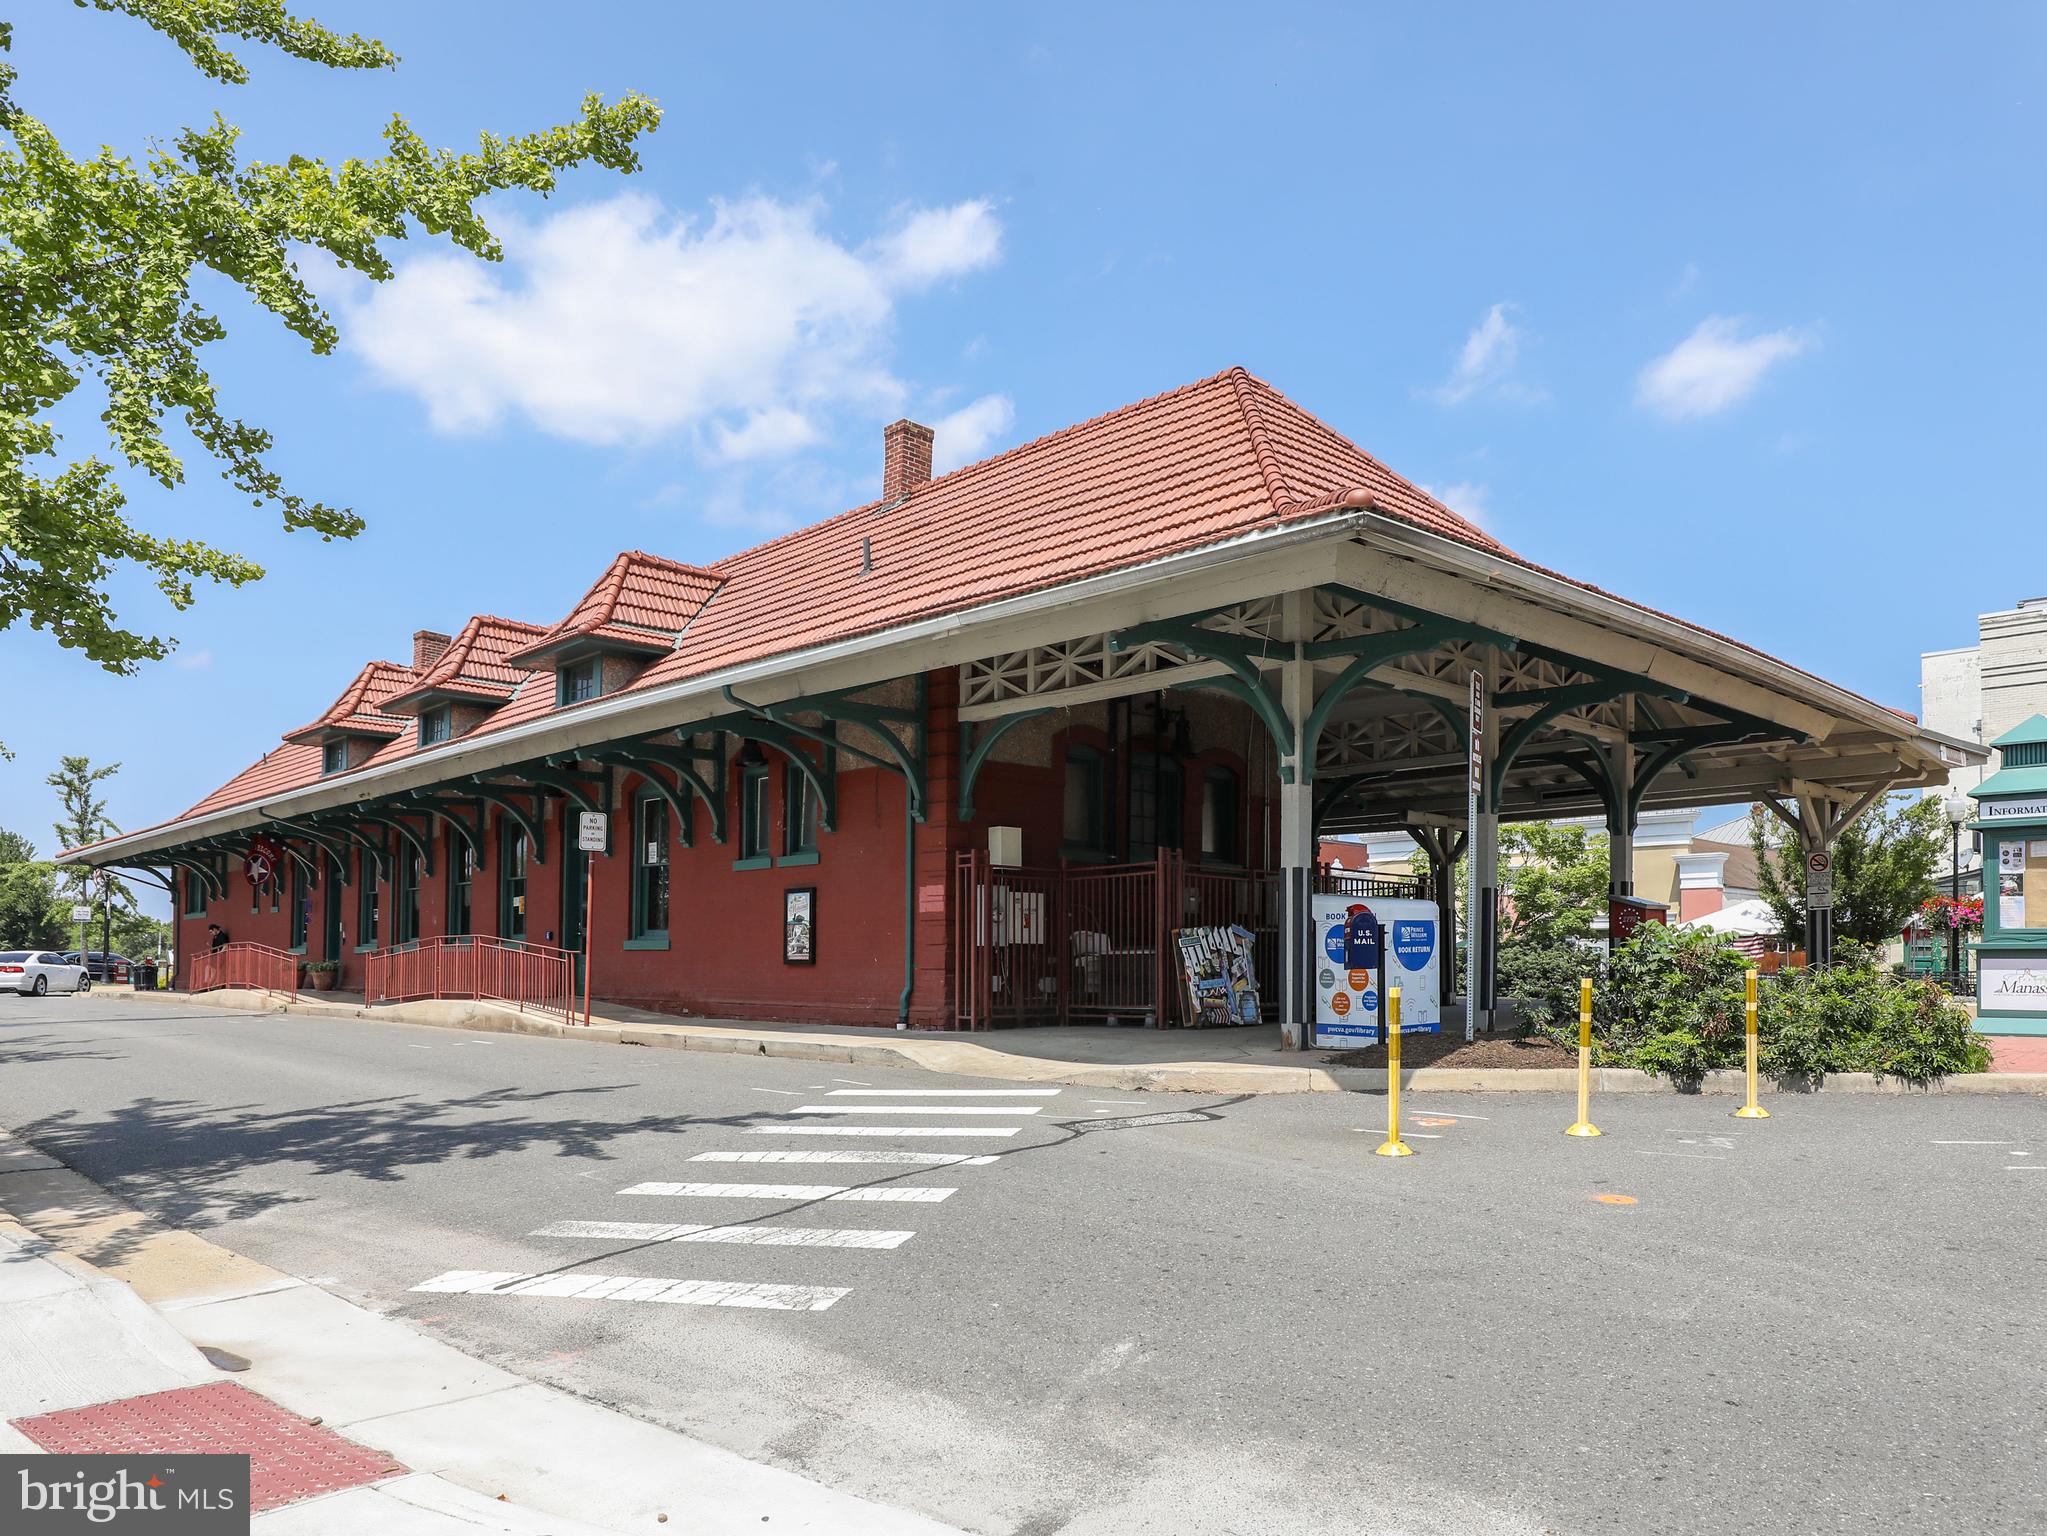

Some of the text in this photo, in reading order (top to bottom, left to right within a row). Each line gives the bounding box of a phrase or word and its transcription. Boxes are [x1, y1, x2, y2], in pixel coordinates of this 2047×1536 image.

[1357, 929, 1373, 937] U.S.
[1412, 945, 1431, 953] RETURN
[1994, 980, 2047, 994] Manas
